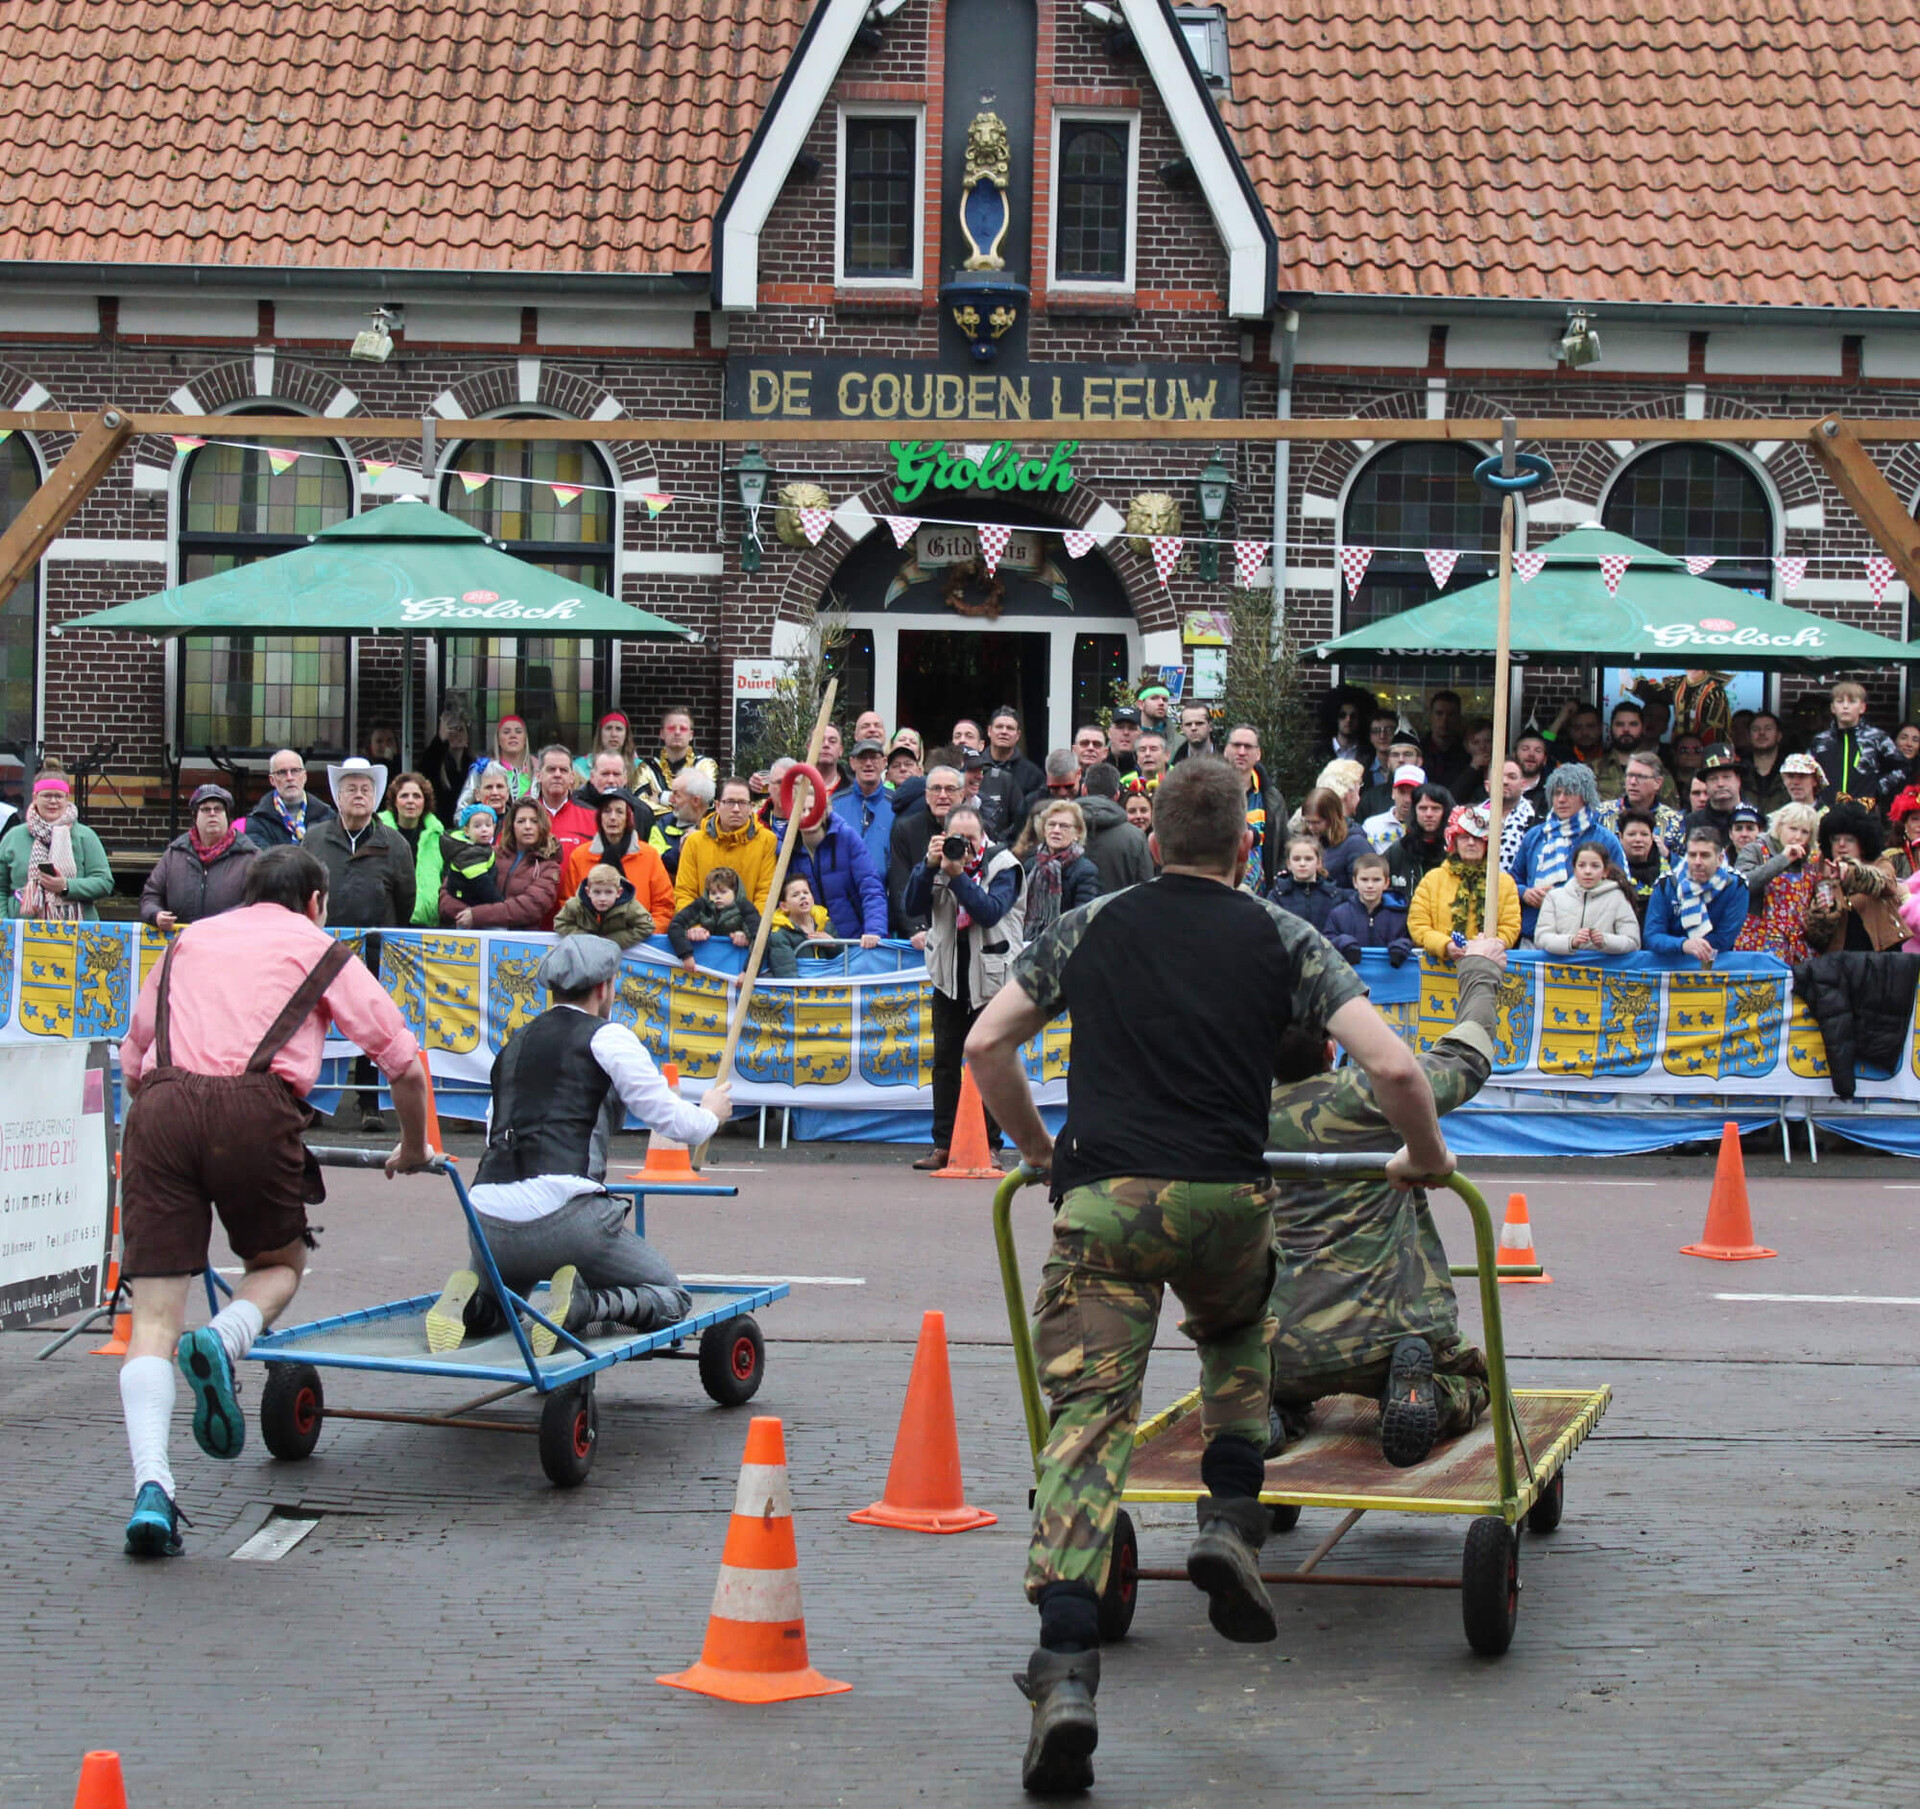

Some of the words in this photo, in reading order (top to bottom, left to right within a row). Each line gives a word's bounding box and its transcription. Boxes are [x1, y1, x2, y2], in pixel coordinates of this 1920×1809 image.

[749, 369, 812, 416] DE
[838, 372, 1031, 420] GOUDEN
[1052, 376, 1218, 421] LEEUW
[889, 440, 1080, 503] Grolsch
[400, 596, 582, 622] Grolsch
[1642, 624, 1825, 648] Grolsch
[737, 675, 776, 690] Duvel
